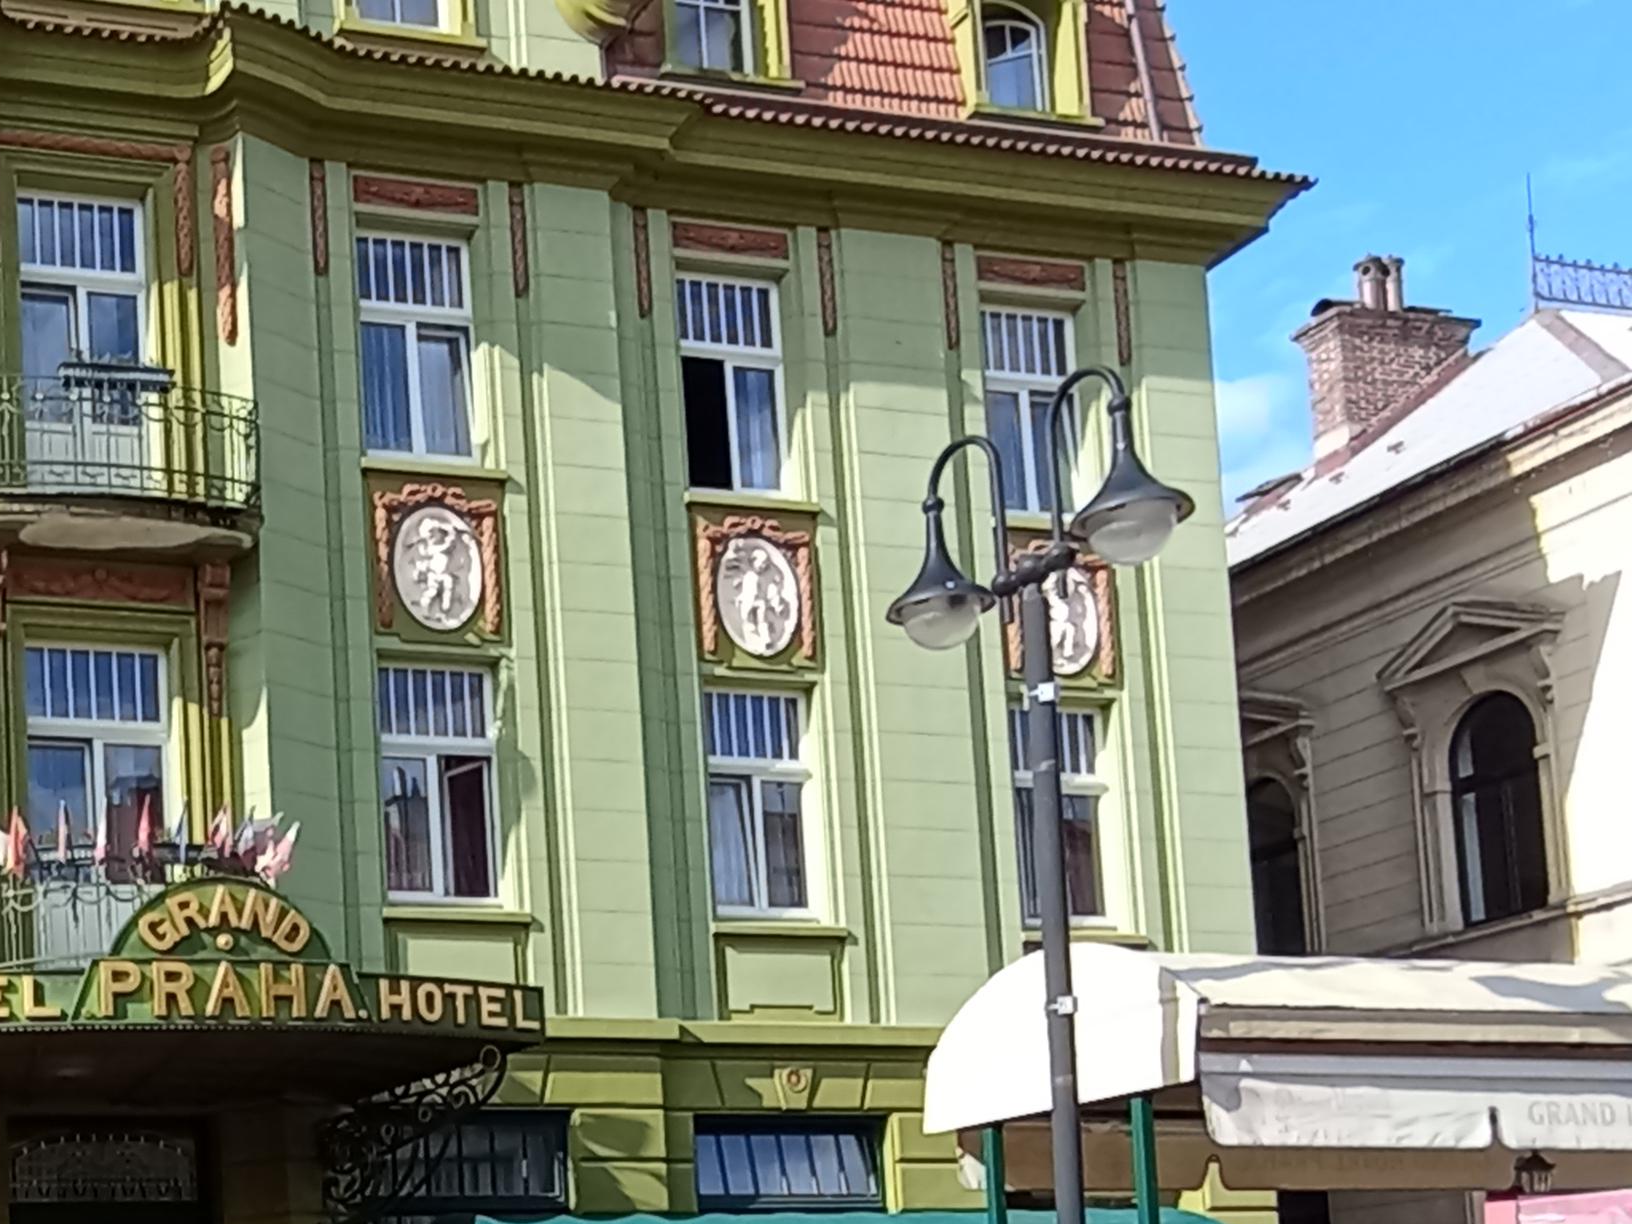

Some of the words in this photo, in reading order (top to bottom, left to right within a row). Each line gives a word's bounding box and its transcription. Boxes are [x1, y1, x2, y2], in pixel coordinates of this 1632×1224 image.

[138, 883, 311, 956] GRAND
[98, 960, 357, 1021] PRAHA
[379, 978, 542, 1031] HOTEL
[1528, 1101, 1616, 1127] GRAND
